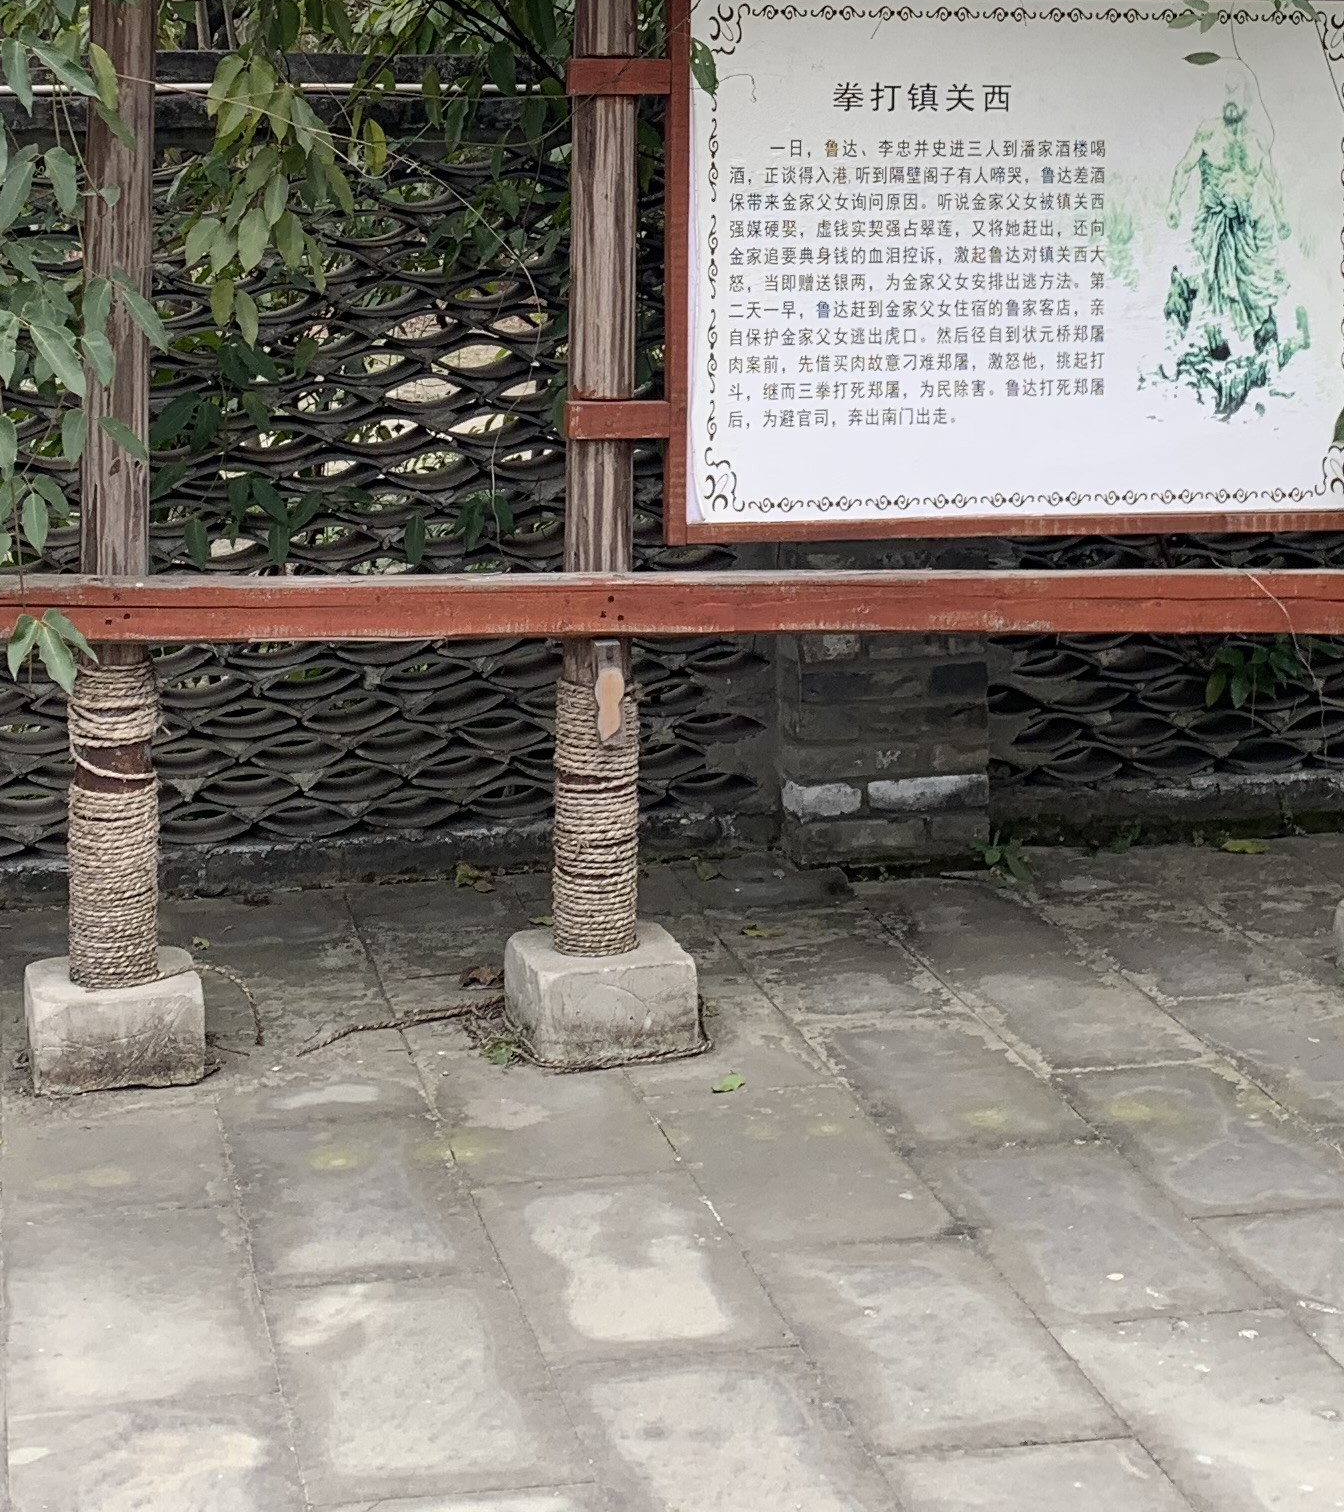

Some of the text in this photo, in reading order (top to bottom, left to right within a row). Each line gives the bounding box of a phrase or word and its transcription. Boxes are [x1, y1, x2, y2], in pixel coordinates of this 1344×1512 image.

[832, 81, 1013, 113] 拳打镇关西
[729, 192, 1105, 212] 保带来金家父女询问原因。听说金家父女被镇关西
[729, 246, 1105, 266] 金家追要典身钱的血泪控诉，激起鲁达对镇关西大
[729, 272, 1105, 292] 怒，当即赠送银两，为金家父女安排出逃方法。第
[728, 299, 1105, 320] 二天一早，鲁达赶到金家父女住宿的鲁家客店，亲
[728, 325, 1105, 347] 自保护金家父女逃出虎口。然后径自到状元桥郑屠
[727, 378, 1105, 402] 斗，继而三拳打死郑屠，为民除害。鲁达打死郑屠
[727, 407, 956, 429] 后，为避官司，奔出南门出走。
